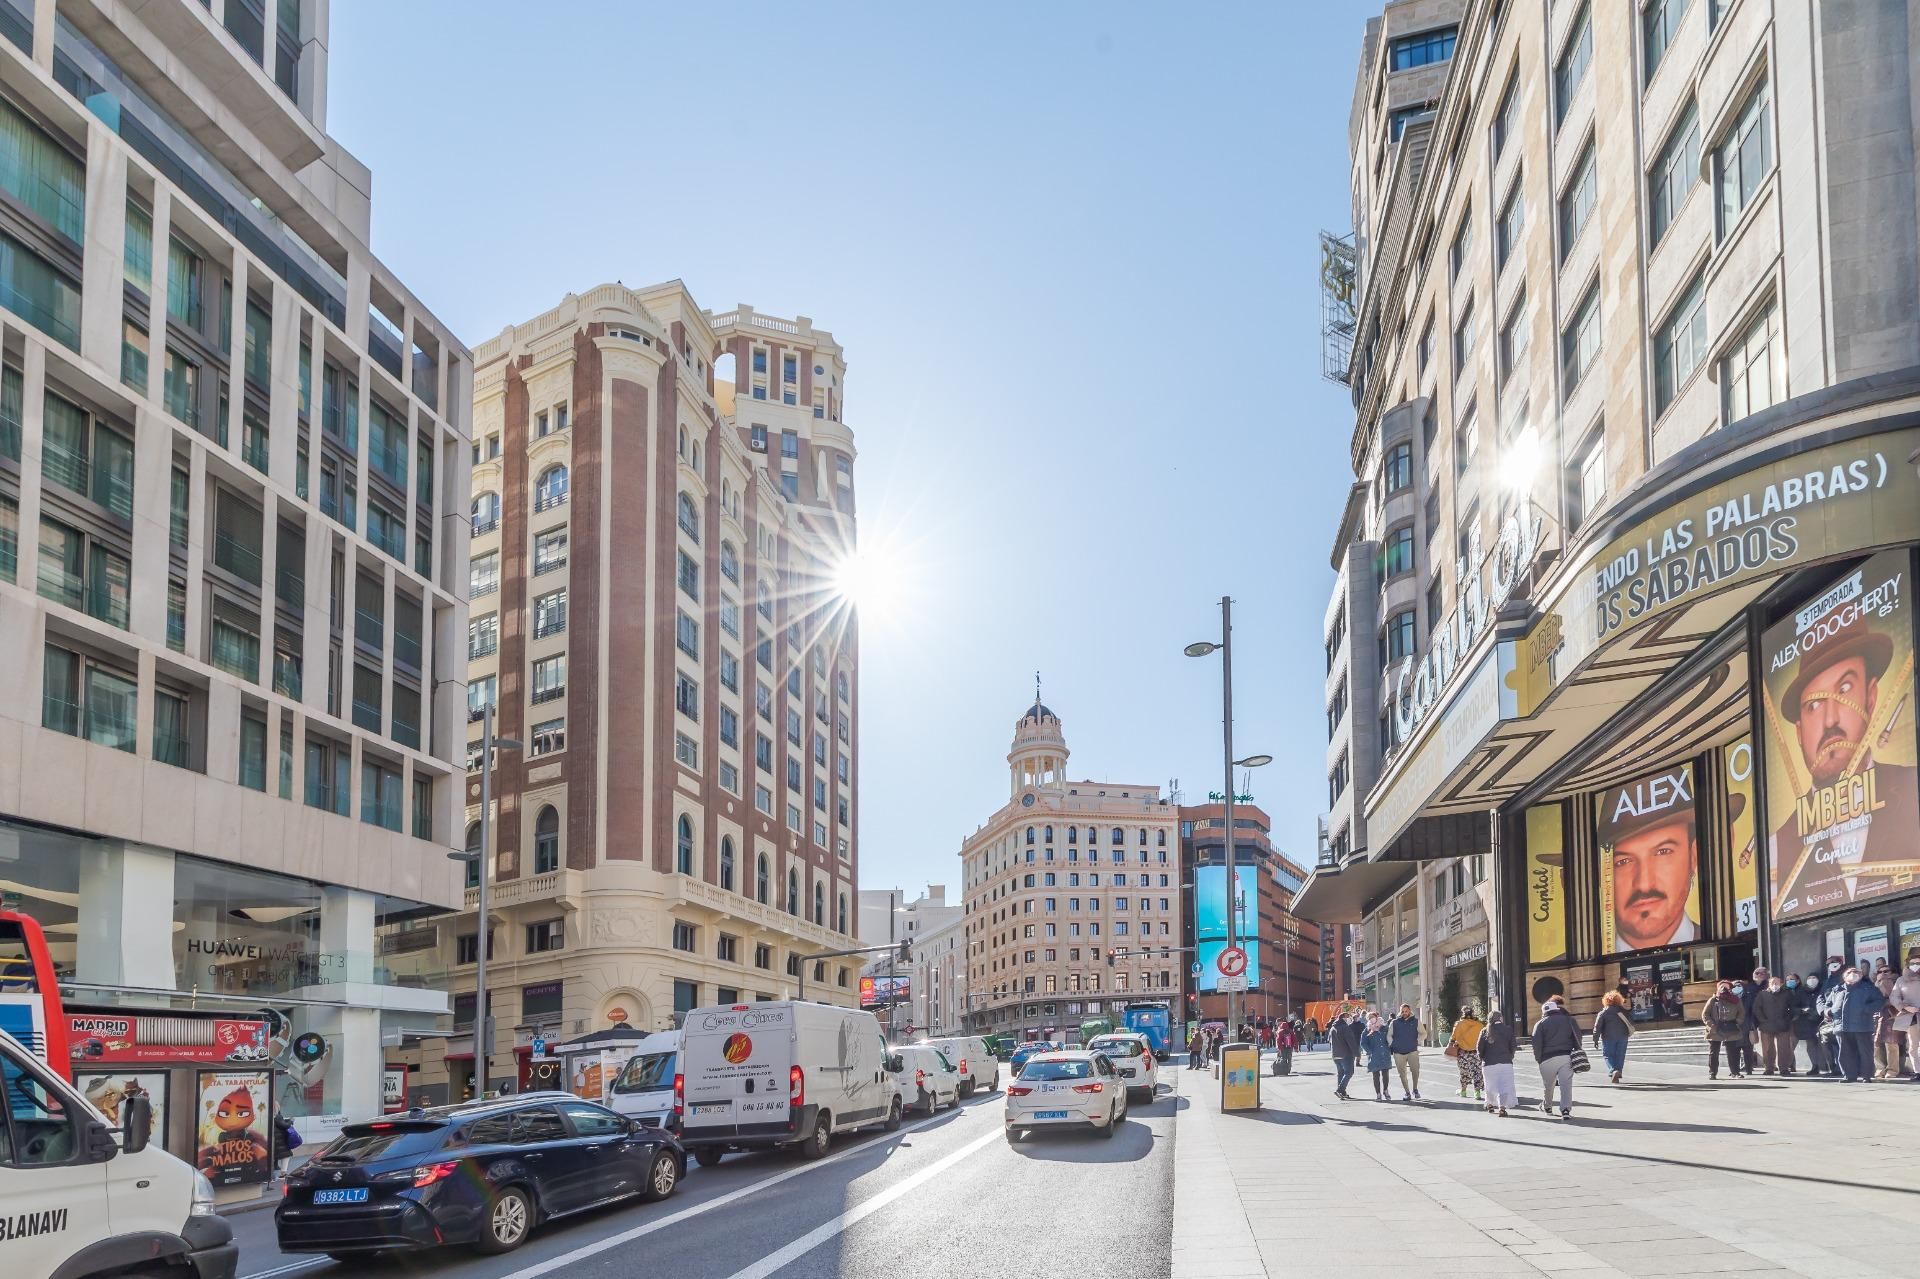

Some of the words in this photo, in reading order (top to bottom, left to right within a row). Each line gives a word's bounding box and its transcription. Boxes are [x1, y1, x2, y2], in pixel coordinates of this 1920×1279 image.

[1647, 519, 1693, 566] LAS
[1628, 517, 1798, 618] SÁBADOS
[1810, 581, 1854, 622] TEMPORADA
[1771, 639, 1800, 673] ALEX
[1802, 573, 1902, 651] O'DOGHERTY
[1612, 768, 1693, 824] ALEX
[1795, 766, 1886, 838] IMBÉCIL
[1814, 838, 1859, 865] Capitol
[1533, 867, 1553, 923] Capitol
[188, 939, 262, 960] HUAWEI
[72, 1019, 129, 1032] MADRID
[212, 1151, 254, 1167] MALOS
[218, 1139, 252, 1155] TIPOS
[320, 1191, 345, 1202] 9382
[346, 1189, 367, 1200] LTJ
